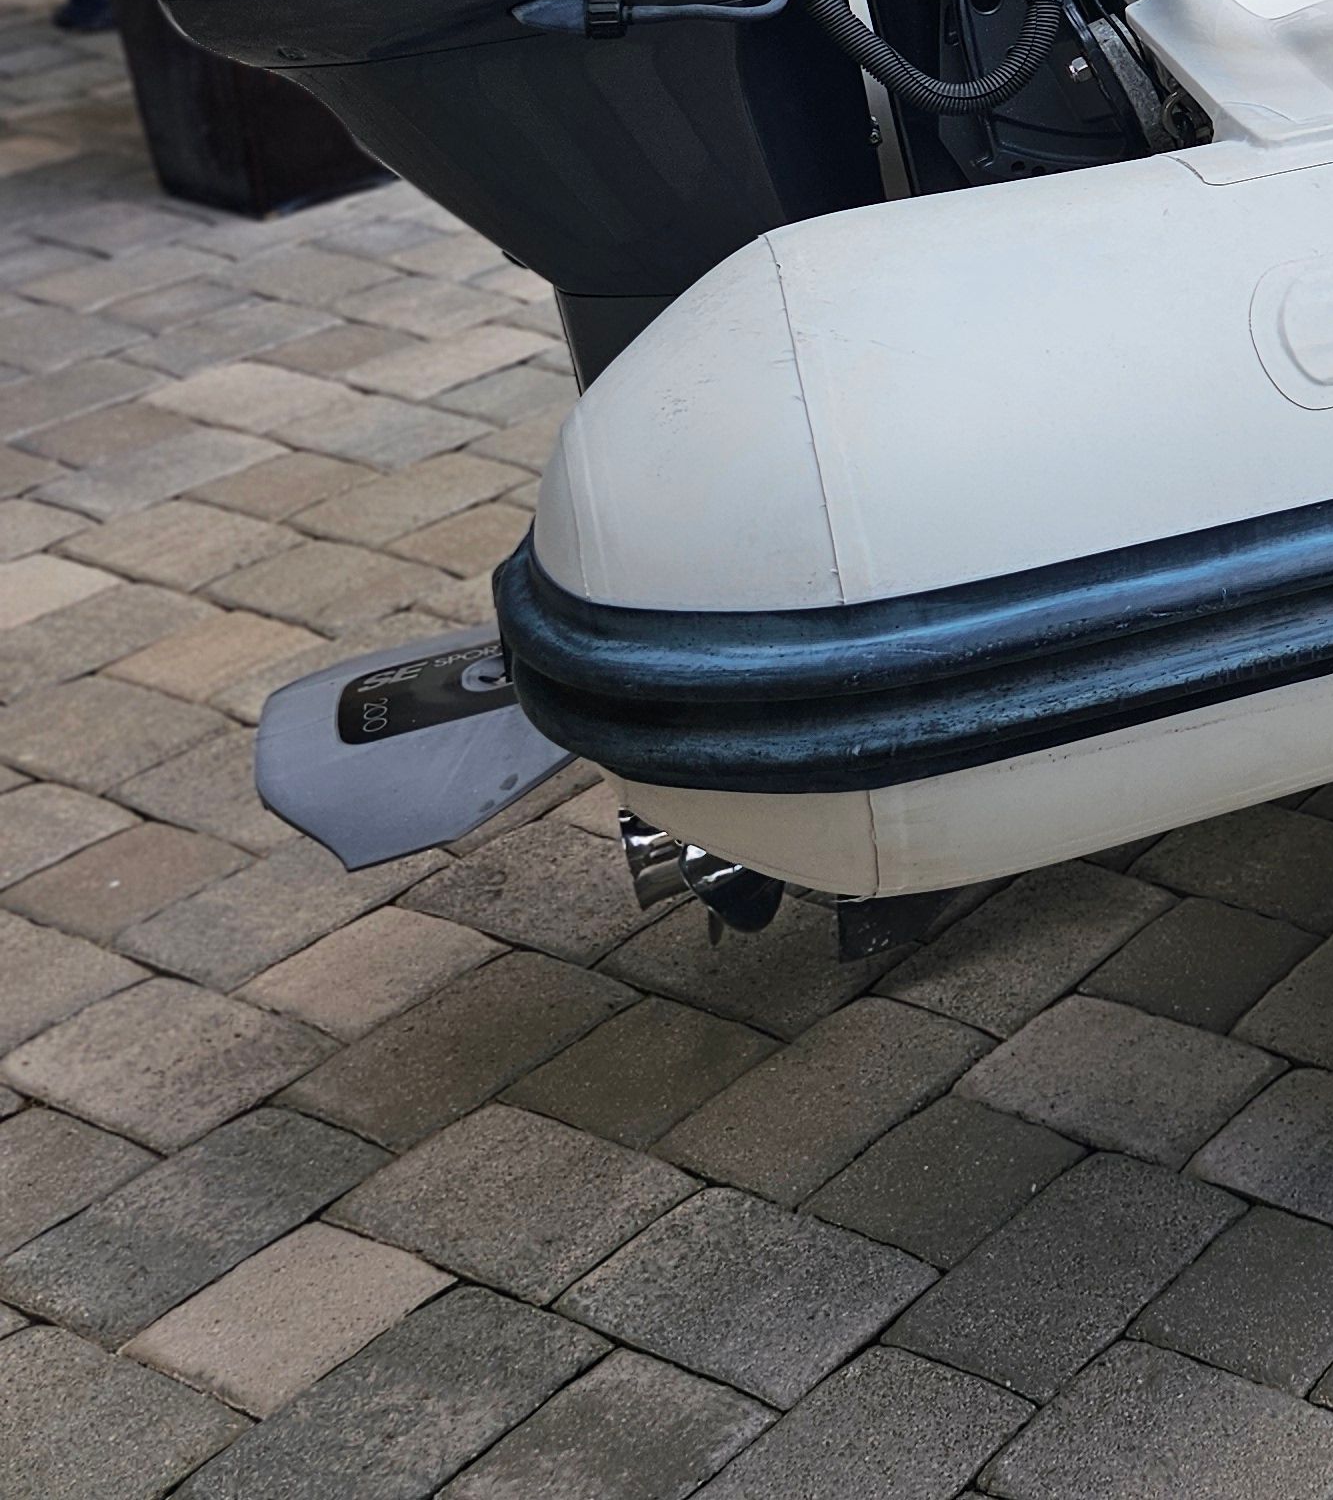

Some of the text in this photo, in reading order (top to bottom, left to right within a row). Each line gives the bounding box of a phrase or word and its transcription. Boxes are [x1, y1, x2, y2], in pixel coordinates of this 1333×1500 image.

[357, 643, 504, 693] SE SPOR
[362, 697, 389, 733] 200
